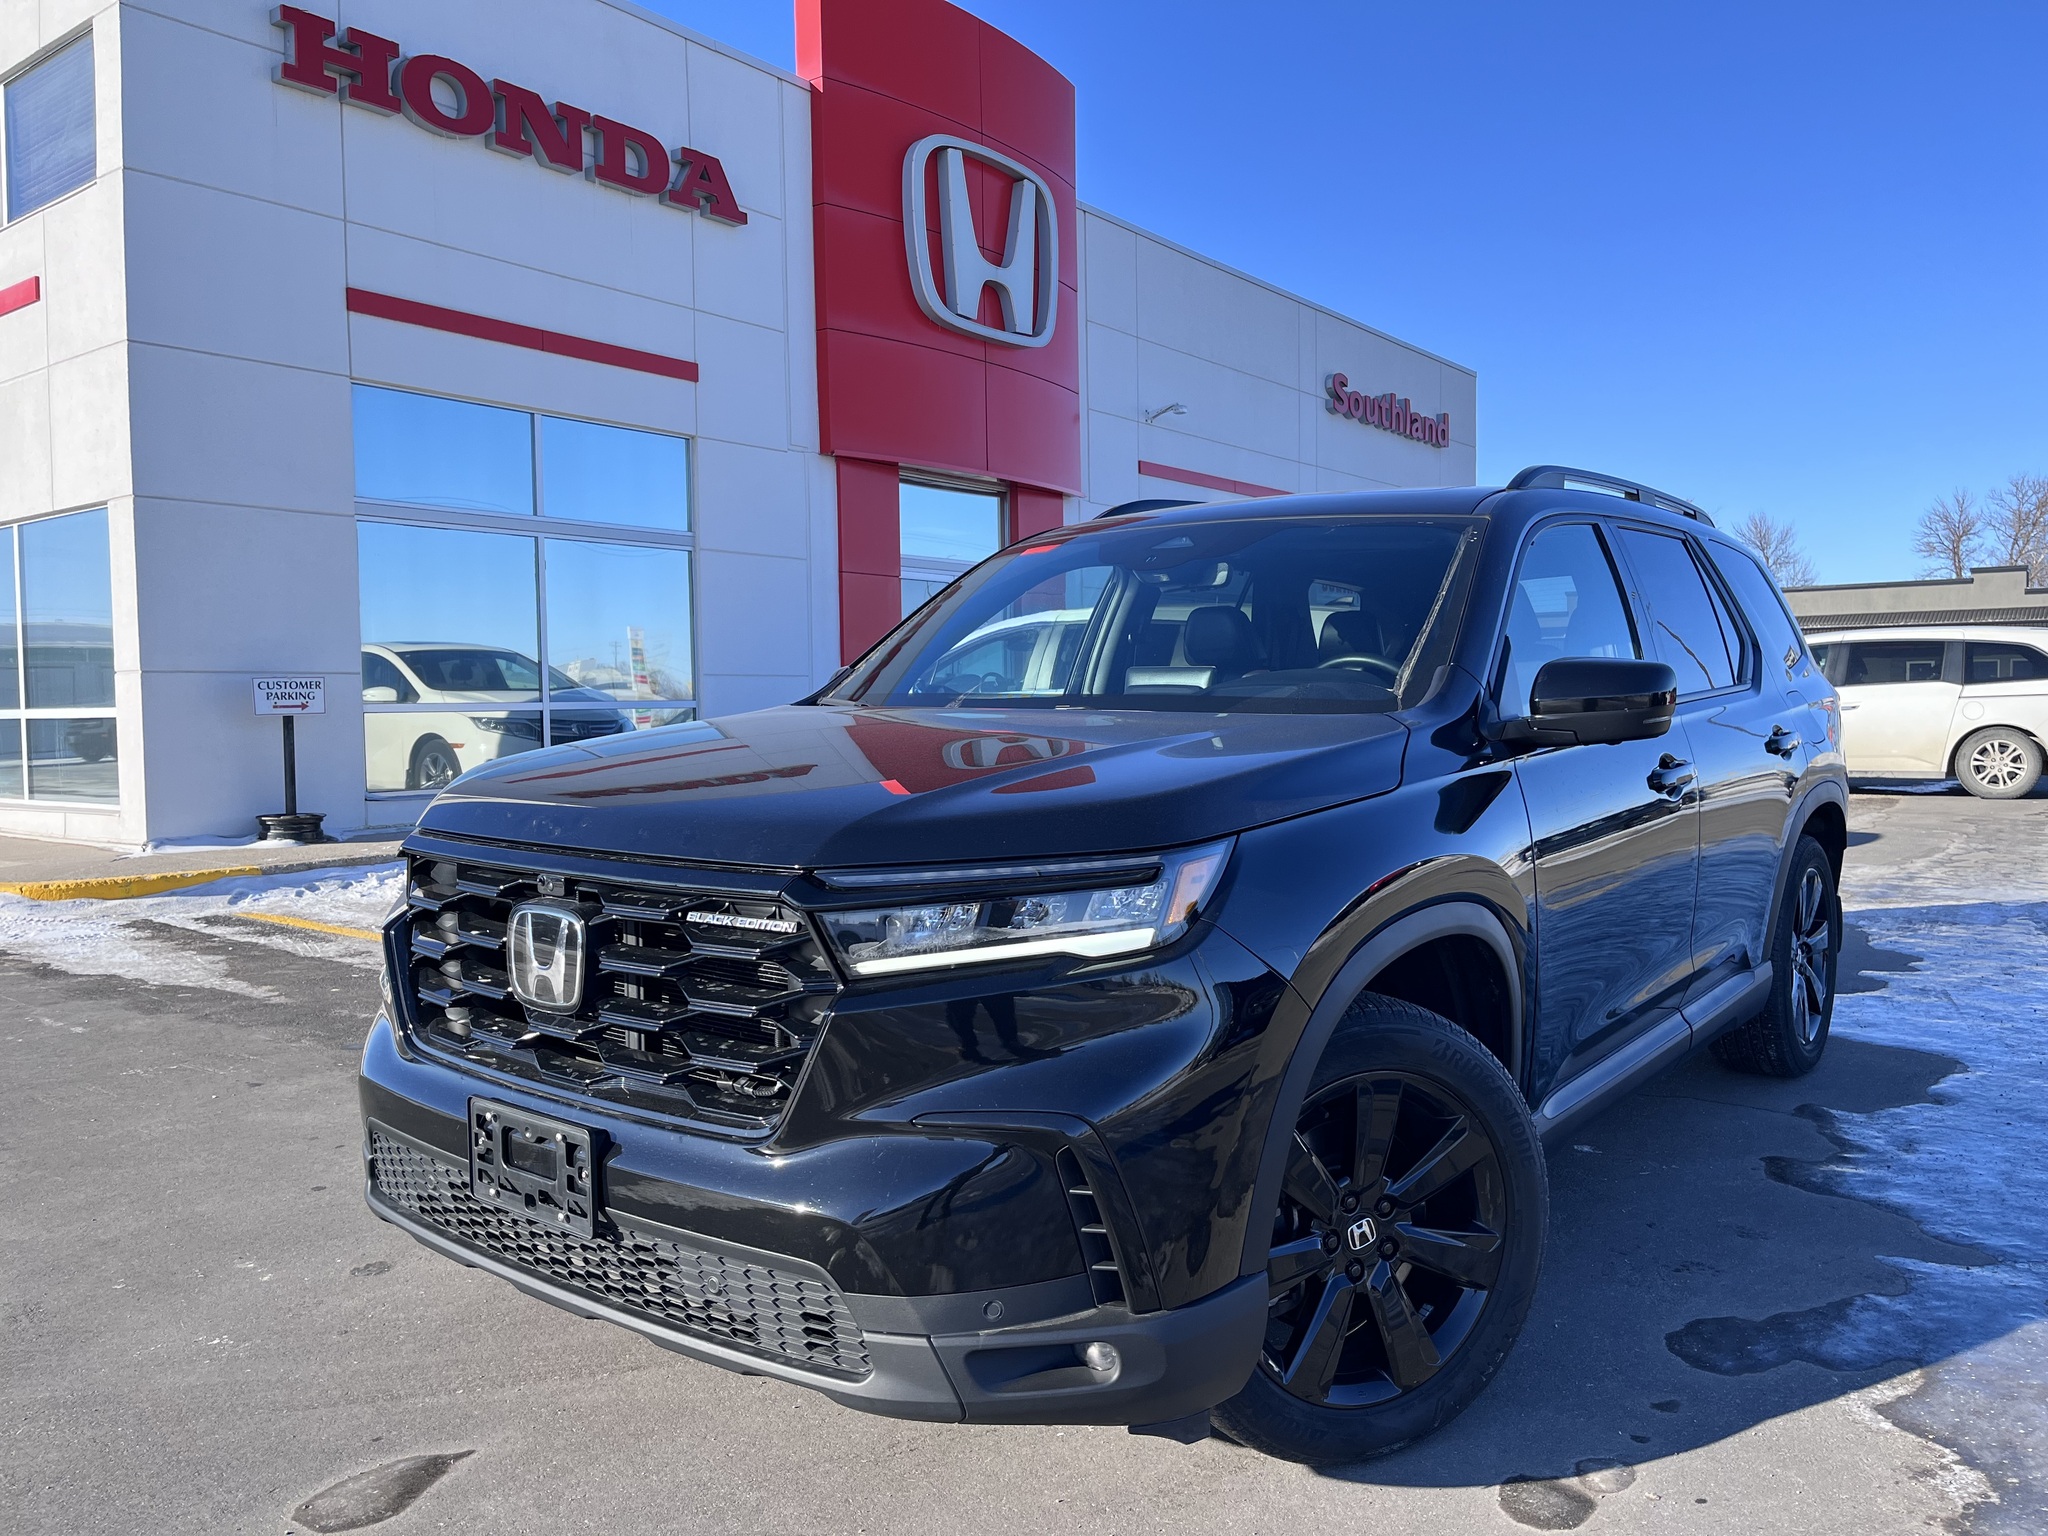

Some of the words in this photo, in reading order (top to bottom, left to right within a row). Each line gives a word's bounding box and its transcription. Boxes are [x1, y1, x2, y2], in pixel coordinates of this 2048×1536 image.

[274, 4, 749, 227] HONDA
[1329, 372, 1450, 448] Southland
[257, 680, 322, 690] CUSTOMER
[266, 691, 316, 701] PARKING
[685, 911, 733, 926] BLACK
[735, 917, 798, 934] EDITION
[1429, 1037, 1538, 1169] BRIDGESTONE
